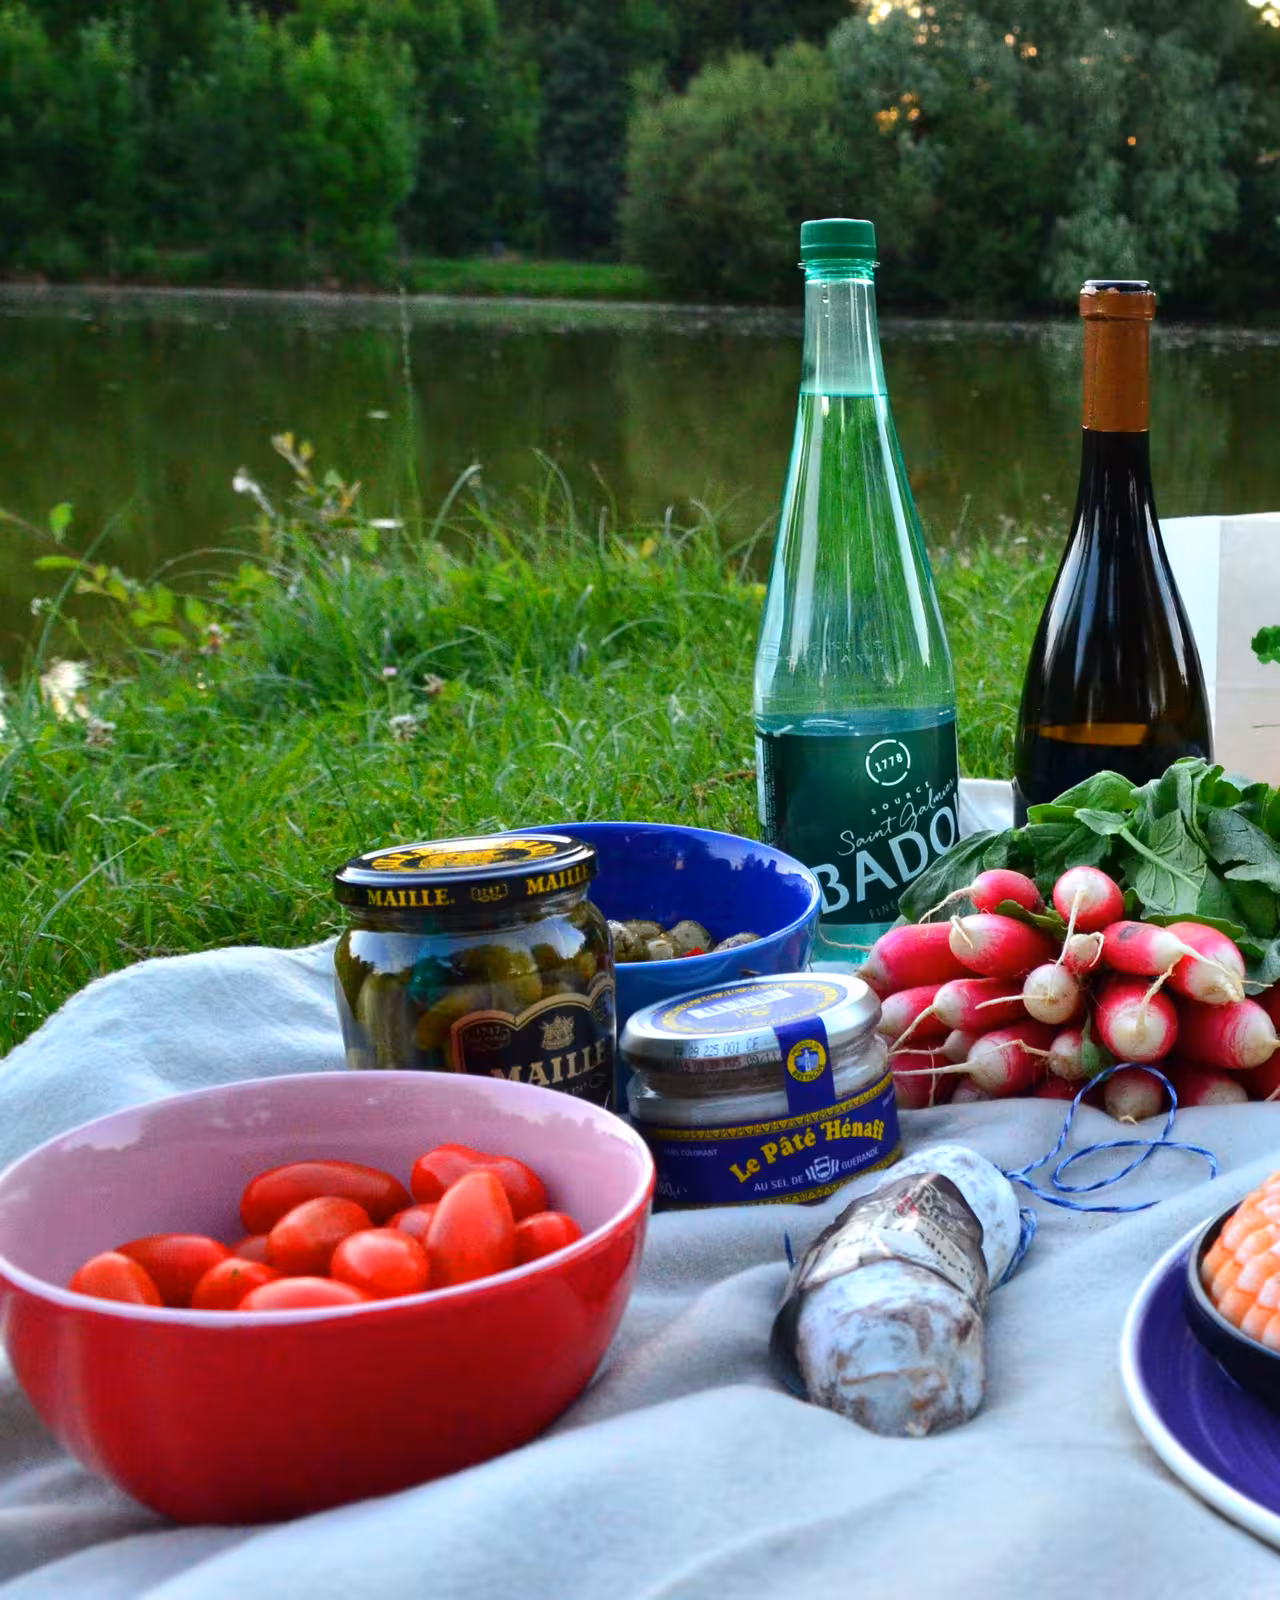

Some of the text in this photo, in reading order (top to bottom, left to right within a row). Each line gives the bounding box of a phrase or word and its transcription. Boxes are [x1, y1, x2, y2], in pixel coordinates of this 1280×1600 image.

[875, 752, 904, 774] 1778
[871, 781, 930, 816] SOURCE
[837, 815, 898, 857] Saint
[526, 862, 590, 895] MAILLE
[367, 887, 452, 908] MAILLE
[489, 1038, 606, 1086] MAILLE
[703, 1043, 720, 1057] 225
[745, 1036, 760, 1050] CE
[729, 1117, 884, 1183] Le Pâté Hénaff
[754, 1146, 880, 1192] AU SEL DE GUERANDE
